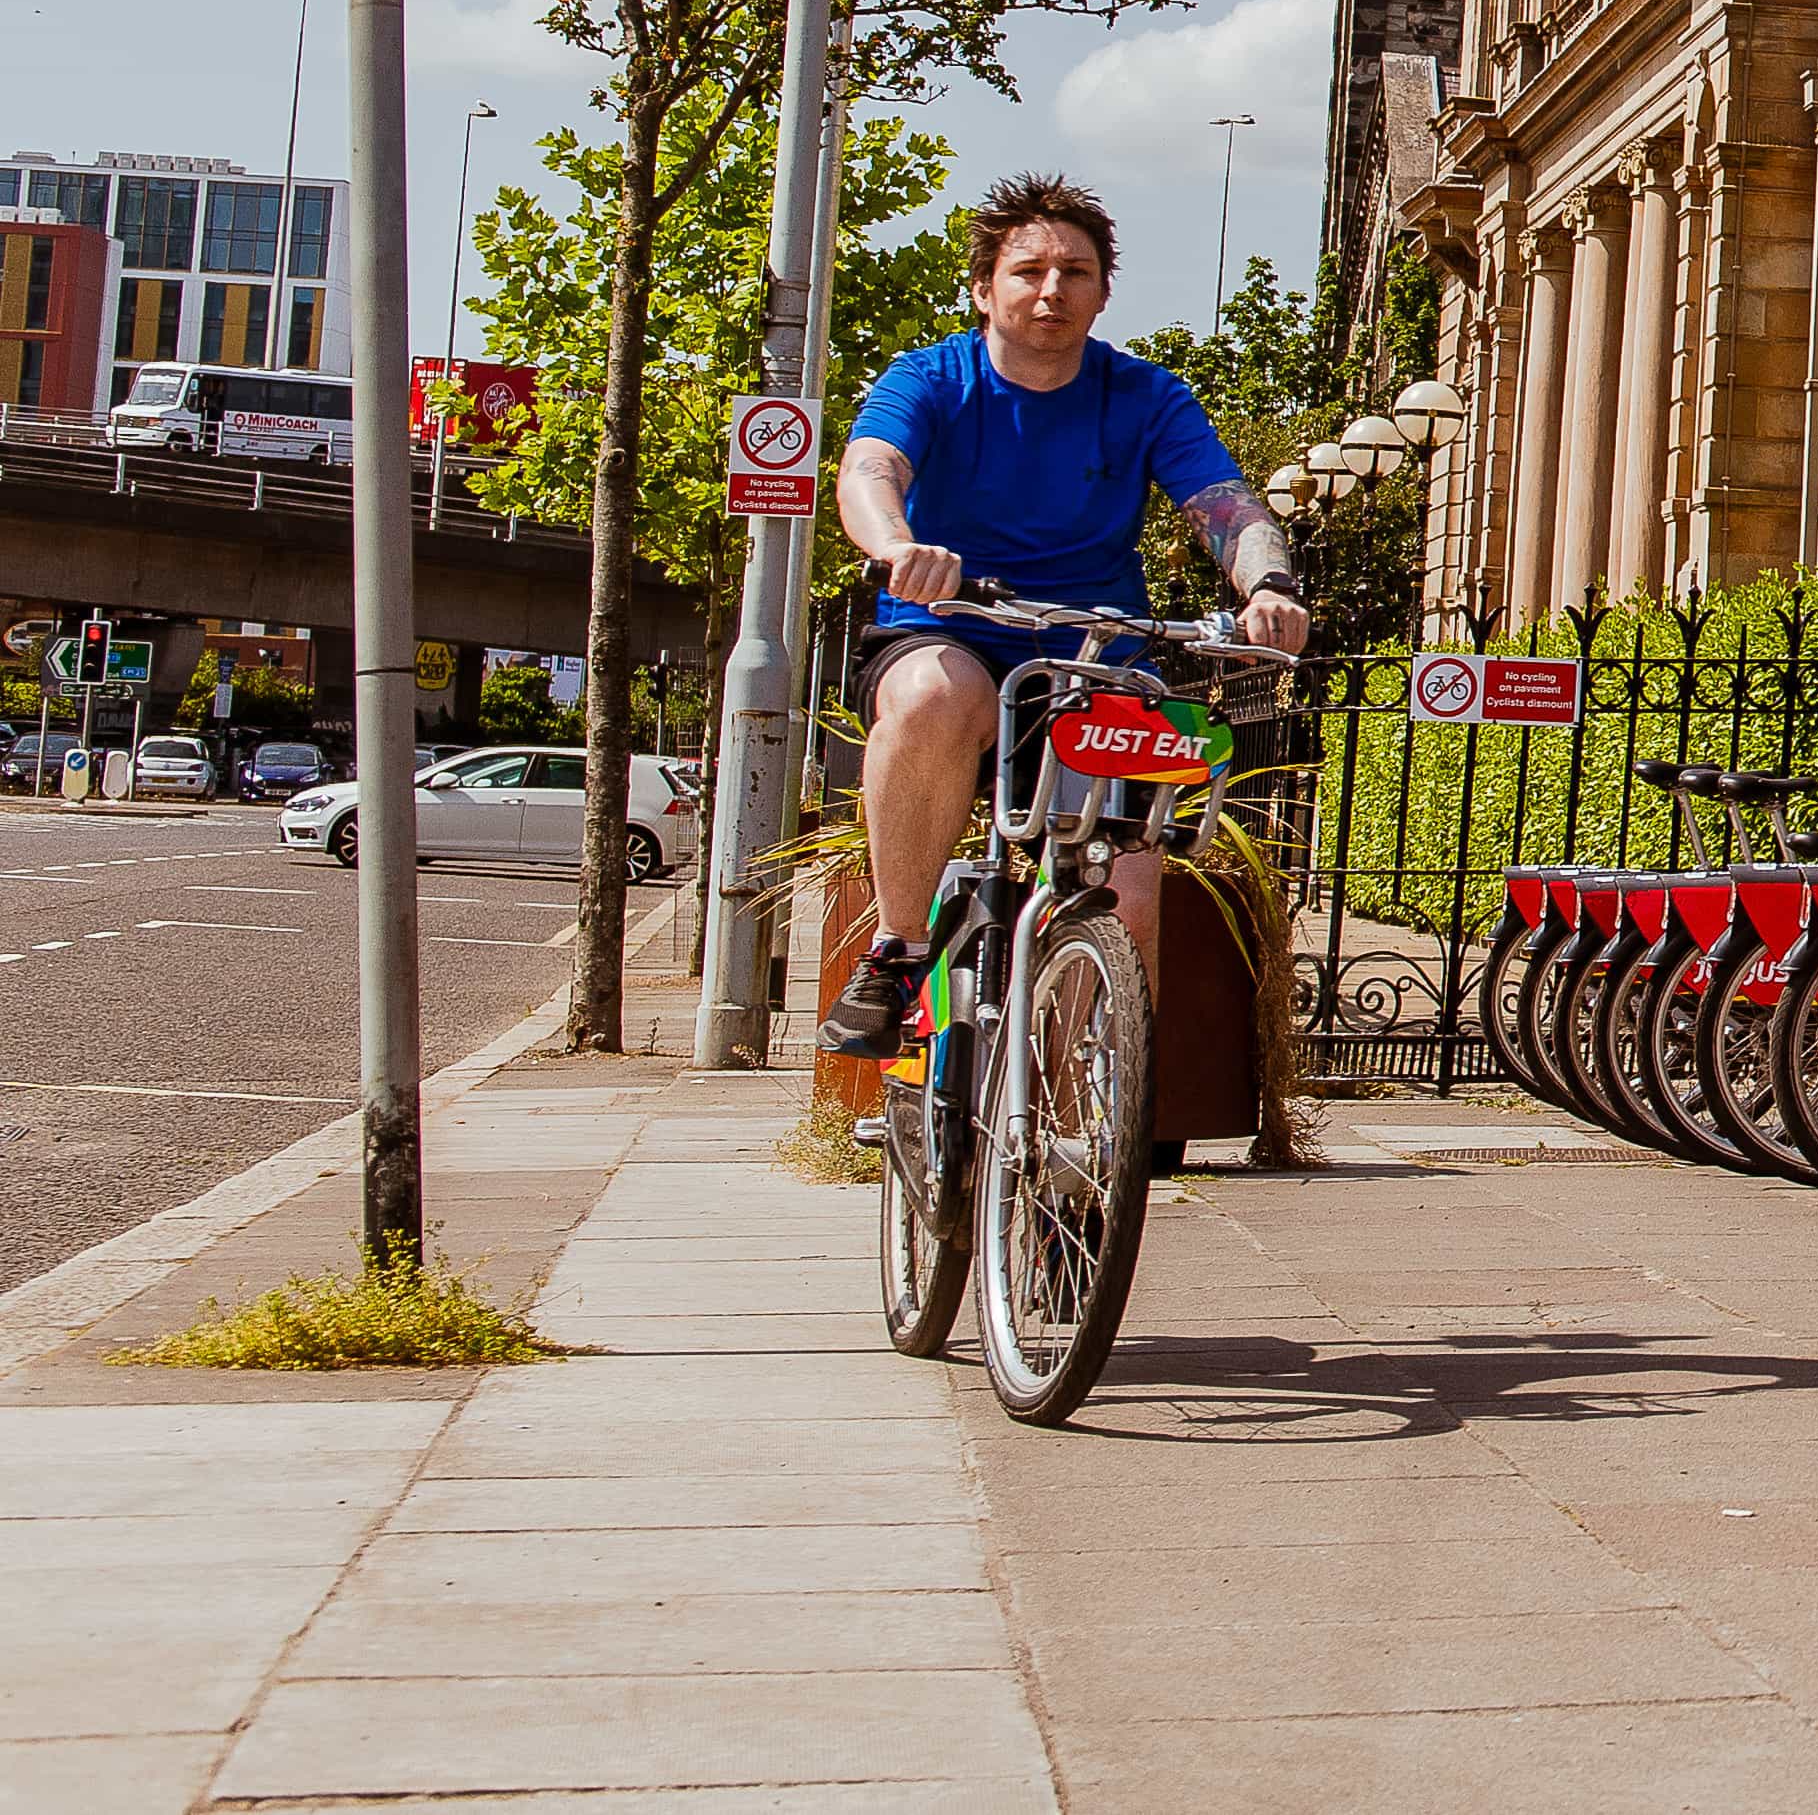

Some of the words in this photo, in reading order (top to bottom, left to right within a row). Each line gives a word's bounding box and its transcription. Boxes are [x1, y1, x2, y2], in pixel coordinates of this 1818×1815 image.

[750, 478, 762, 487] No
[764, 480, 795, 490] cycling
[744, 489, 756, 497] on
[757, 490, 799, 499] pavement
[733, 499, 768, 509] Cyclists
[768, 502, 809, 511] dismount
[1505, 670, 1519, 680] No
[1521, 673, 1557, 684] cycling
[1498, 683, 1512, 692] on
[1513, 684, 1562, 695] pavement
[1486, 696, 1525, 708] Cyclists
[1526, 699, 1573, 710] dismount
[1074, 724, 1150, 754] JUST
[1152, 732, 1212, 760] EAT
